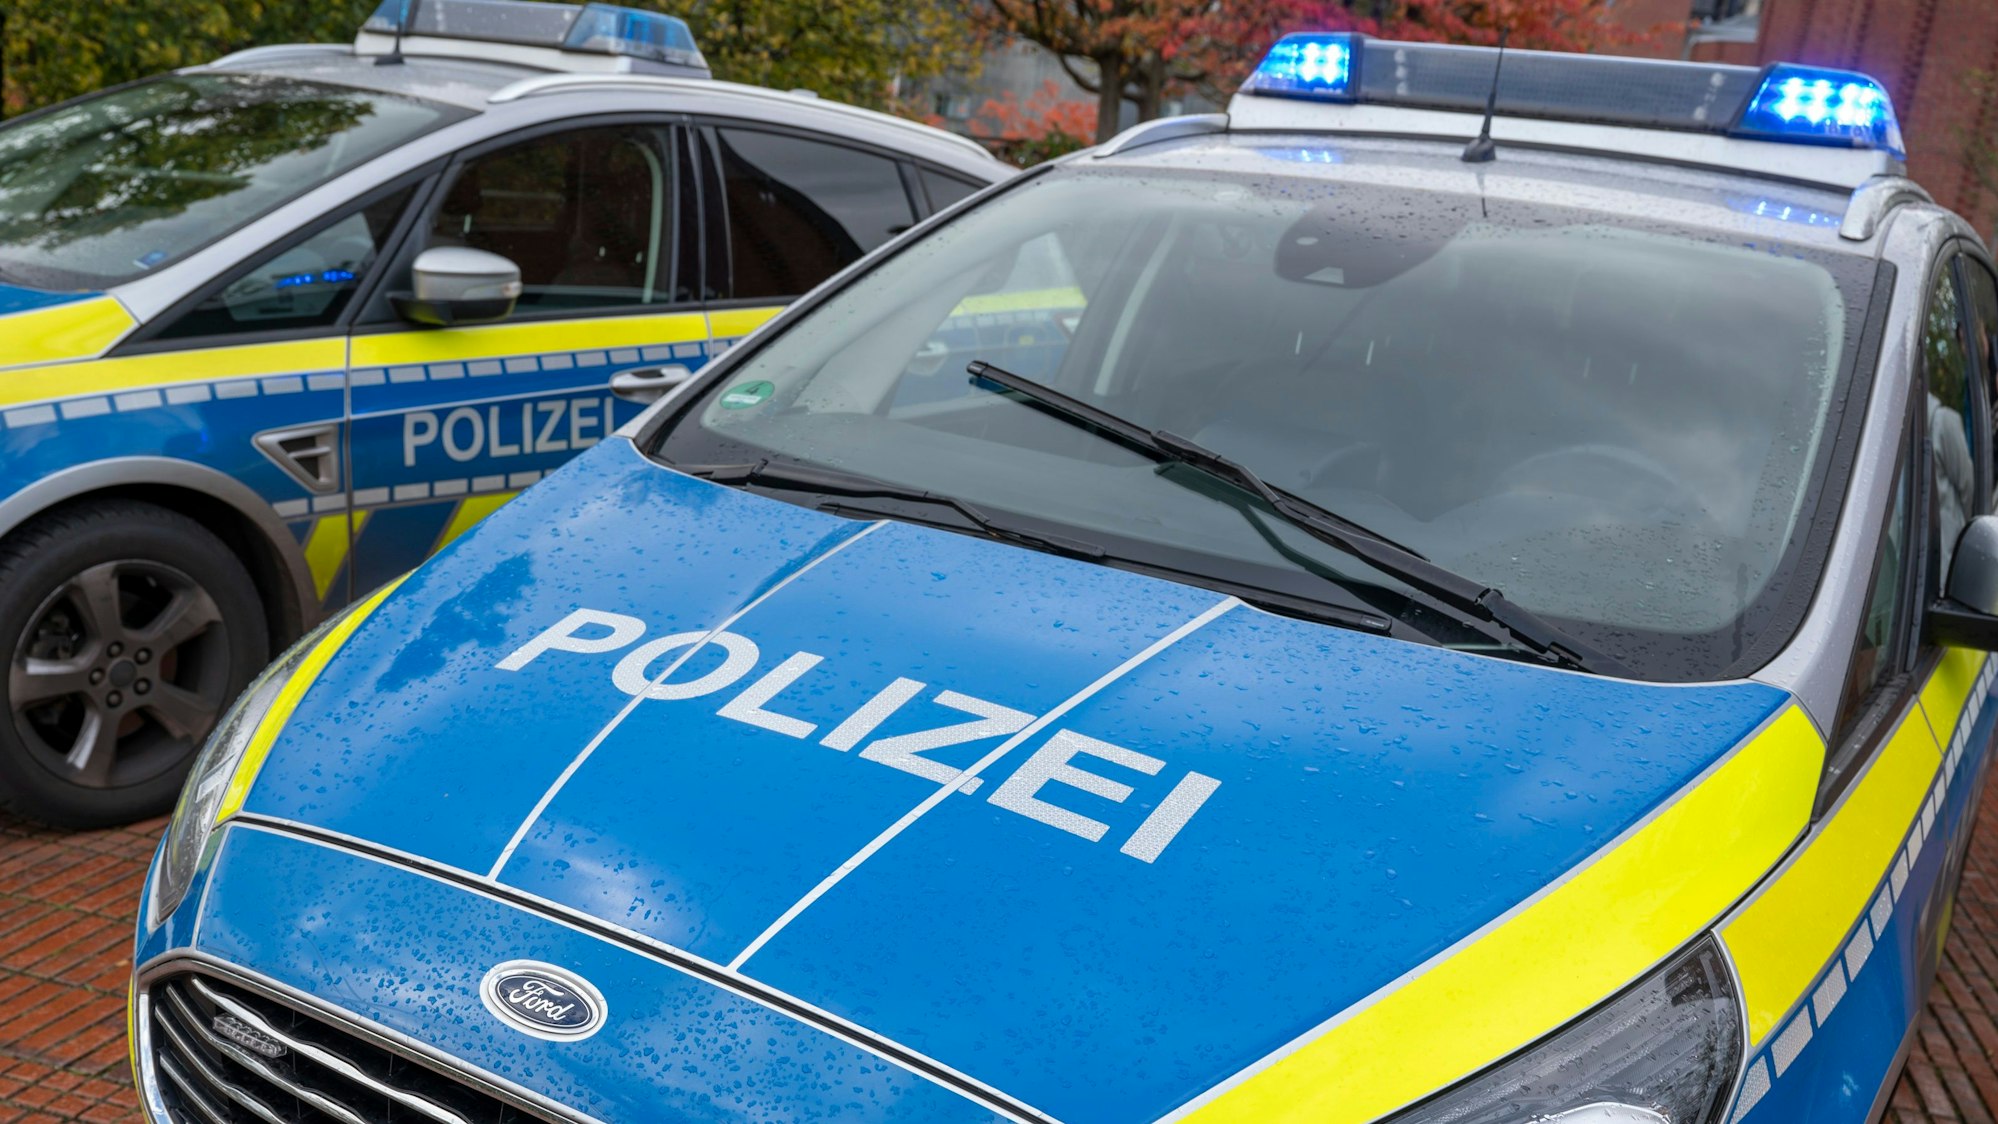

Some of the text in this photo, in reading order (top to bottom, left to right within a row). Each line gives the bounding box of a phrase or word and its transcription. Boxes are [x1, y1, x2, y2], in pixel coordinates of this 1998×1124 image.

[402, 397, 614, 467] POLIZEI
[494, 608, 1222, 864] POLIZEI
[509, 980, 575, 1021] Ford
